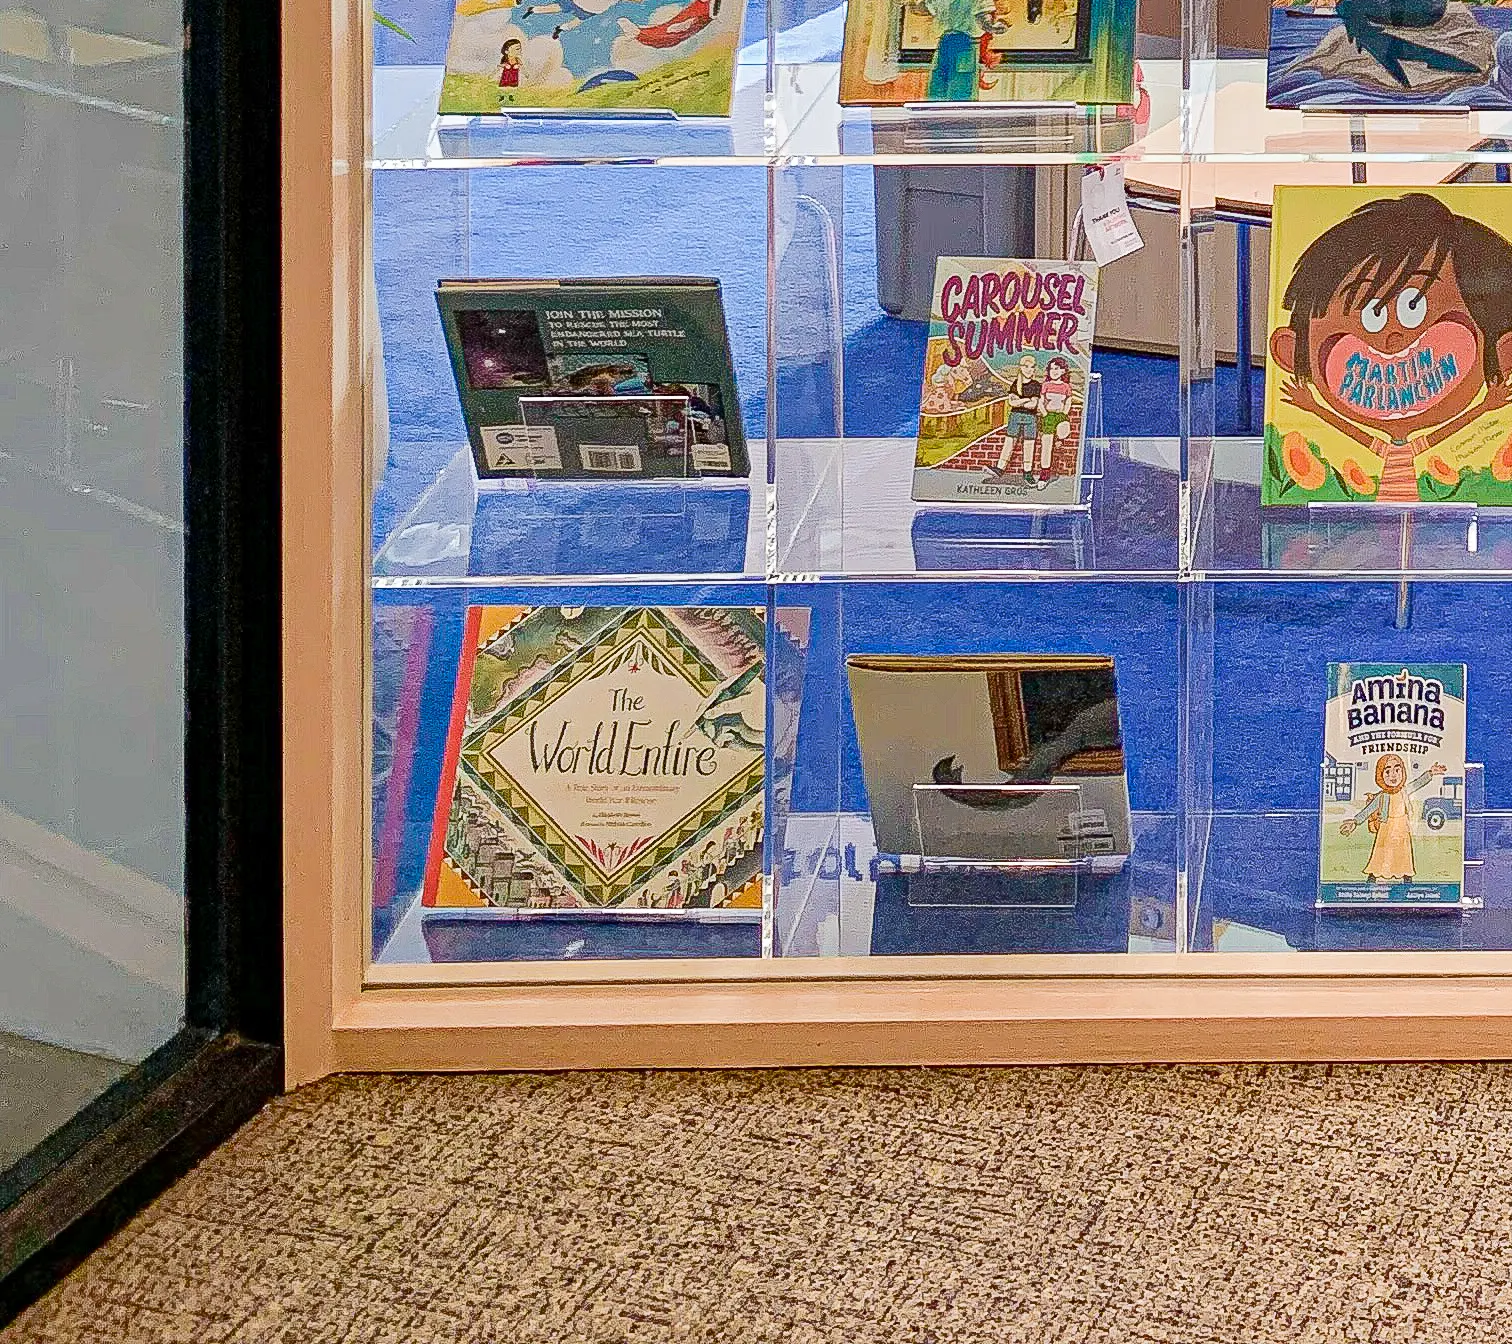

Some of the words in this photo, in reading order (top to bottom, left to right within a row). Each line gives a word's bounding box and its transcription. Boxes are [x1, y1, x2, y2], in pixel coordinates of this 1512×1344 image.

[941, 271, 1086, 324] CAROUSEL
[546, 311, 574, 320] JOIN
[578, 311, 605, 319] THE
[609, 309, 662, 319] MISSION
[631, 320, 659, 328] MOST
[590, 339, 627, 348] WORLD
[943, 312, 1079, 367] SUMMER
[957, 484, 1001, 495] KATHLEEN
[1005, 486, 1028, 496] GROS
[1351, 672, 1442, 705] Amina
[609, 688, 646, 712] The
[1348, 702, 1445, 730] Banana
[1354, 733, 1370, 743] AND
[1372, 732, 1387, 740] THE
[1424, 733, 1438, 742] FOR
[524, 720, 615, 775] World
[619, 719, 718, 776] Entire
[1362, 742, 1429, 755] FRIENDSHIP
